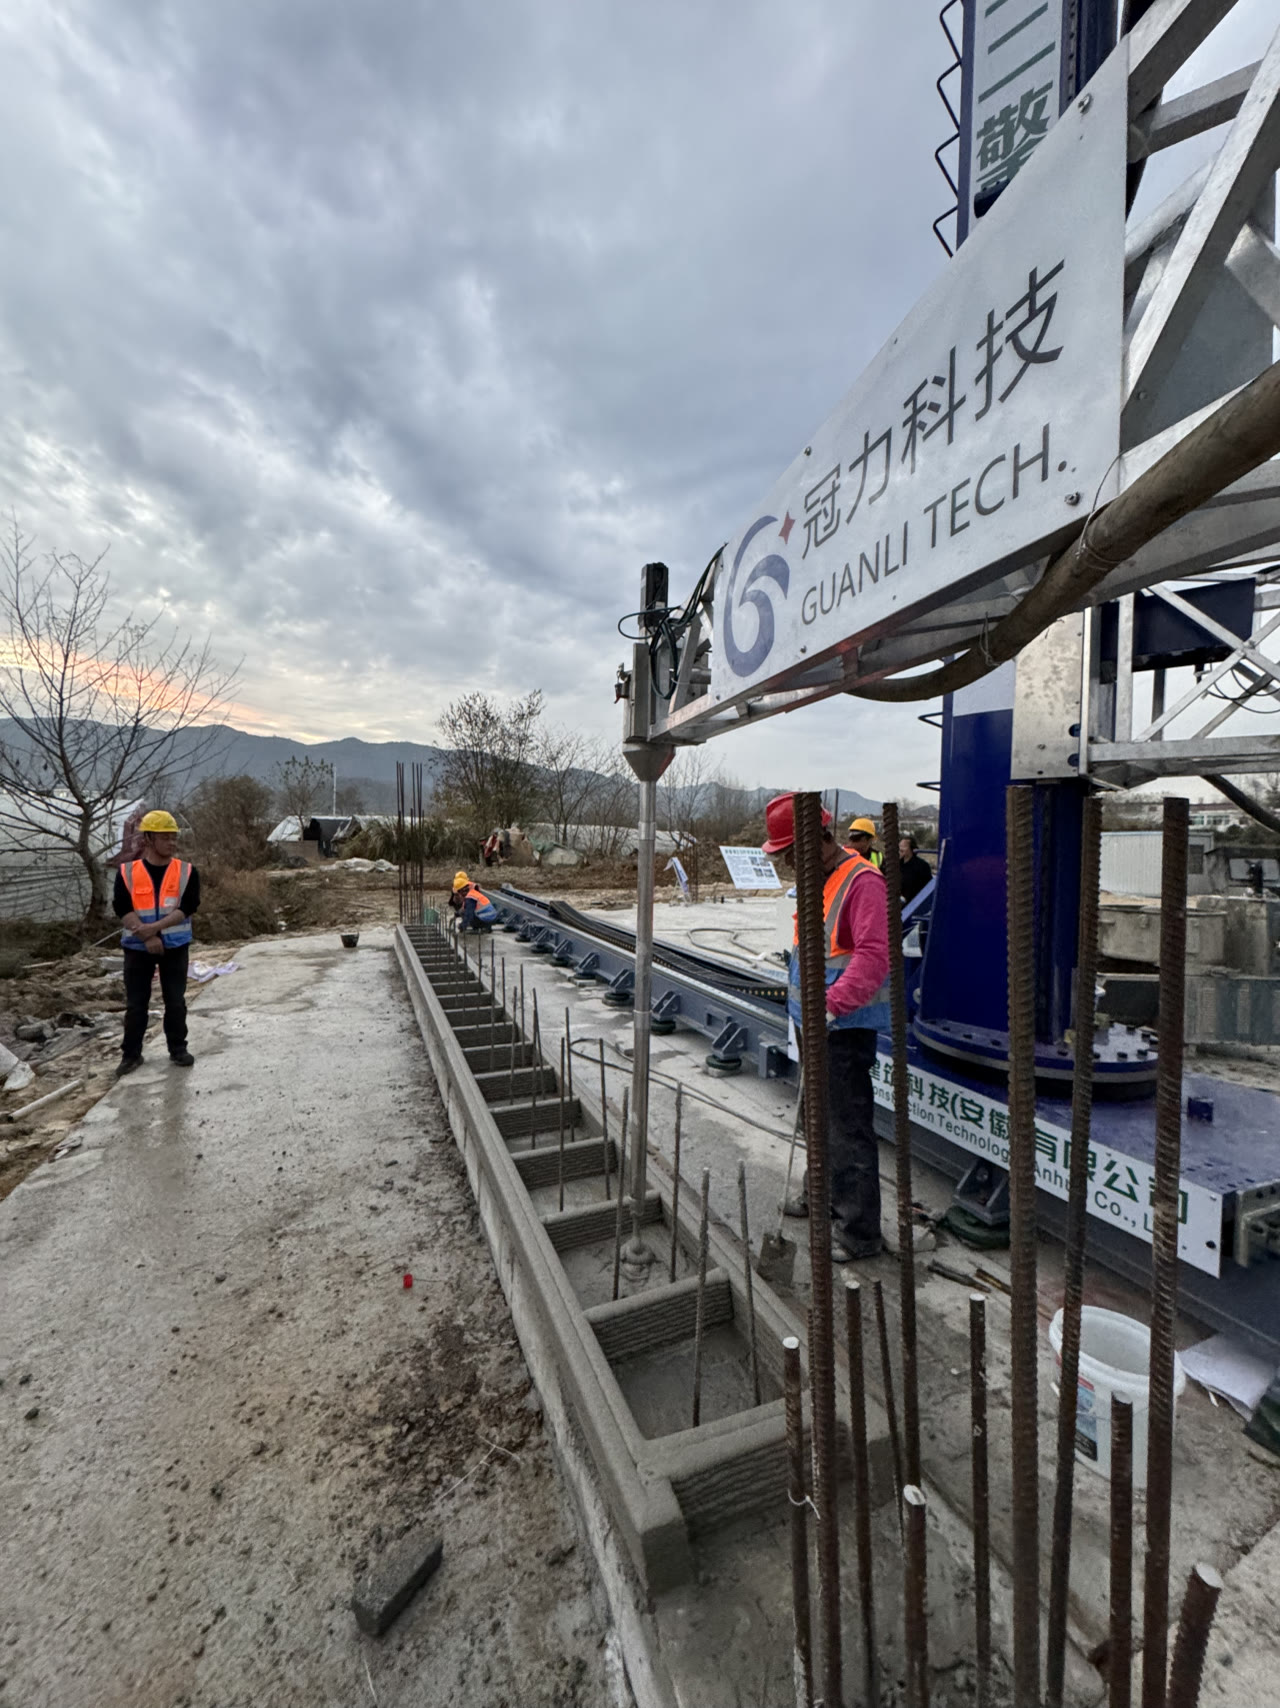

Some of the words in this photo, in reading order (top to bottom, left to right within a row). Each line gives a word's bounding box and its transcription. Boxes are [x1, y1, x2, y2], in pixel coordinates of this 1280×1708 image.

[802, 258, 1065, 560] 冠力科技
[801, 520, 909, 626] GUANLI
[923, 422, 1068, 549] TECH.
[937, 1112, 1012, 1163] Technolog
[1094, 1190, 1137, 1228] Co.,
